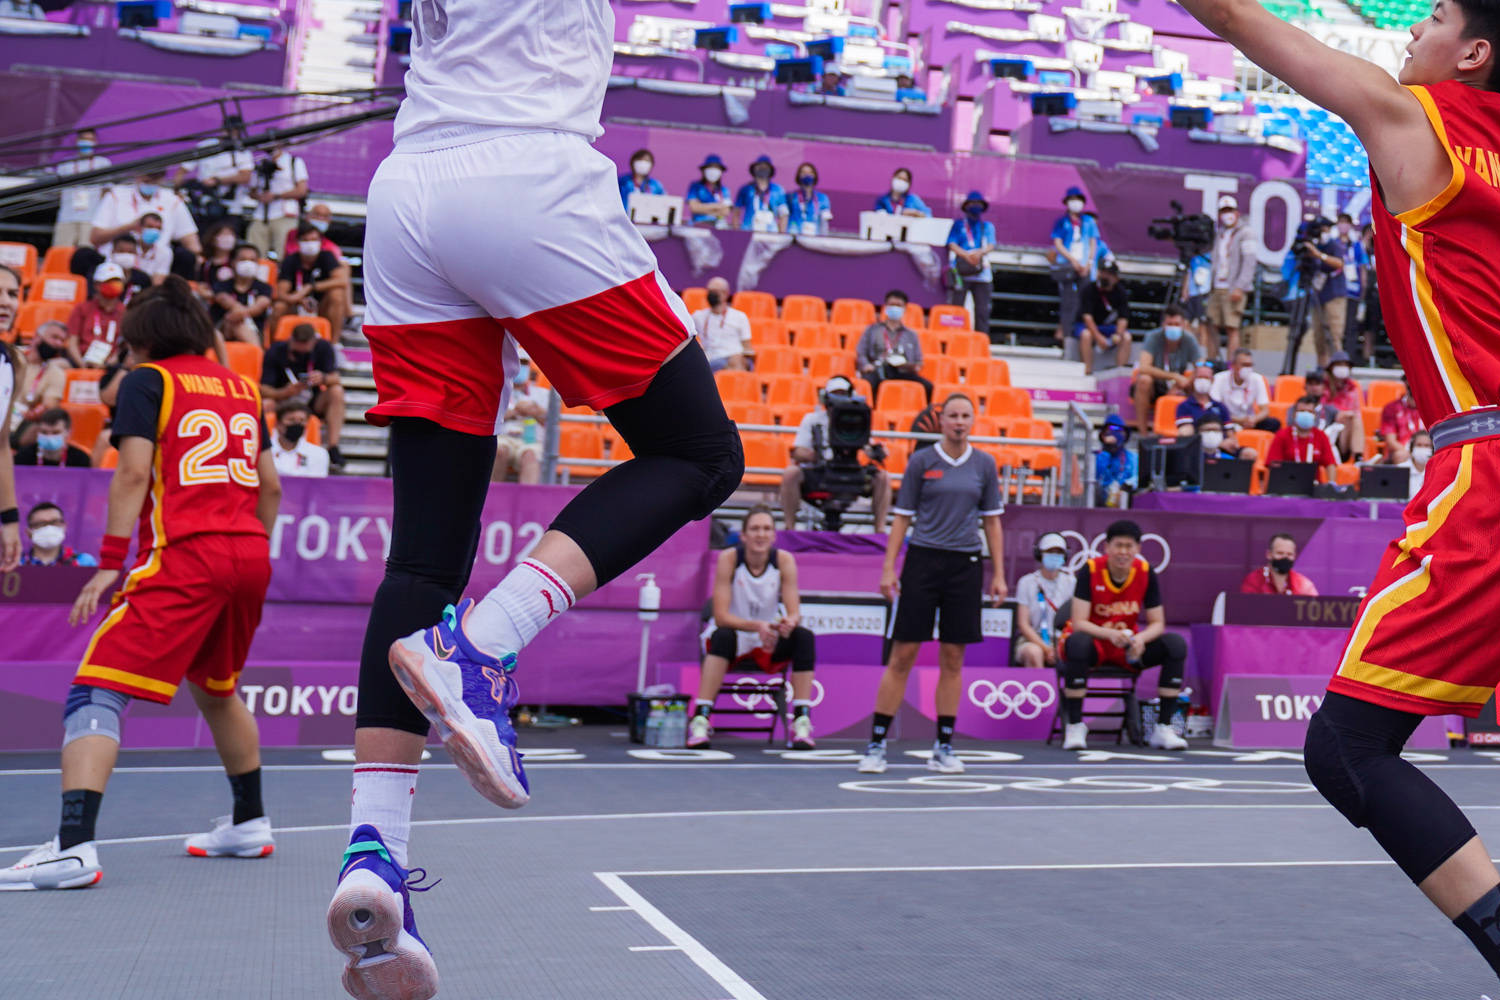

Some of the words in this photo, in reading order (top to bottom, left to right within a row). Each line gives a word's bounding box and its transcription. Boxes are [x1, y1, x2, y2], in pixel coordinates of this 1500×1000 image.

[176, 373, 226, 397] WANG
[177, 408, 260, 487] 23
[1095, 602, 1140, 617] CHINA
[848, 616, 882, 631] 2020
[241, 686, 358, 715] TOKYO
